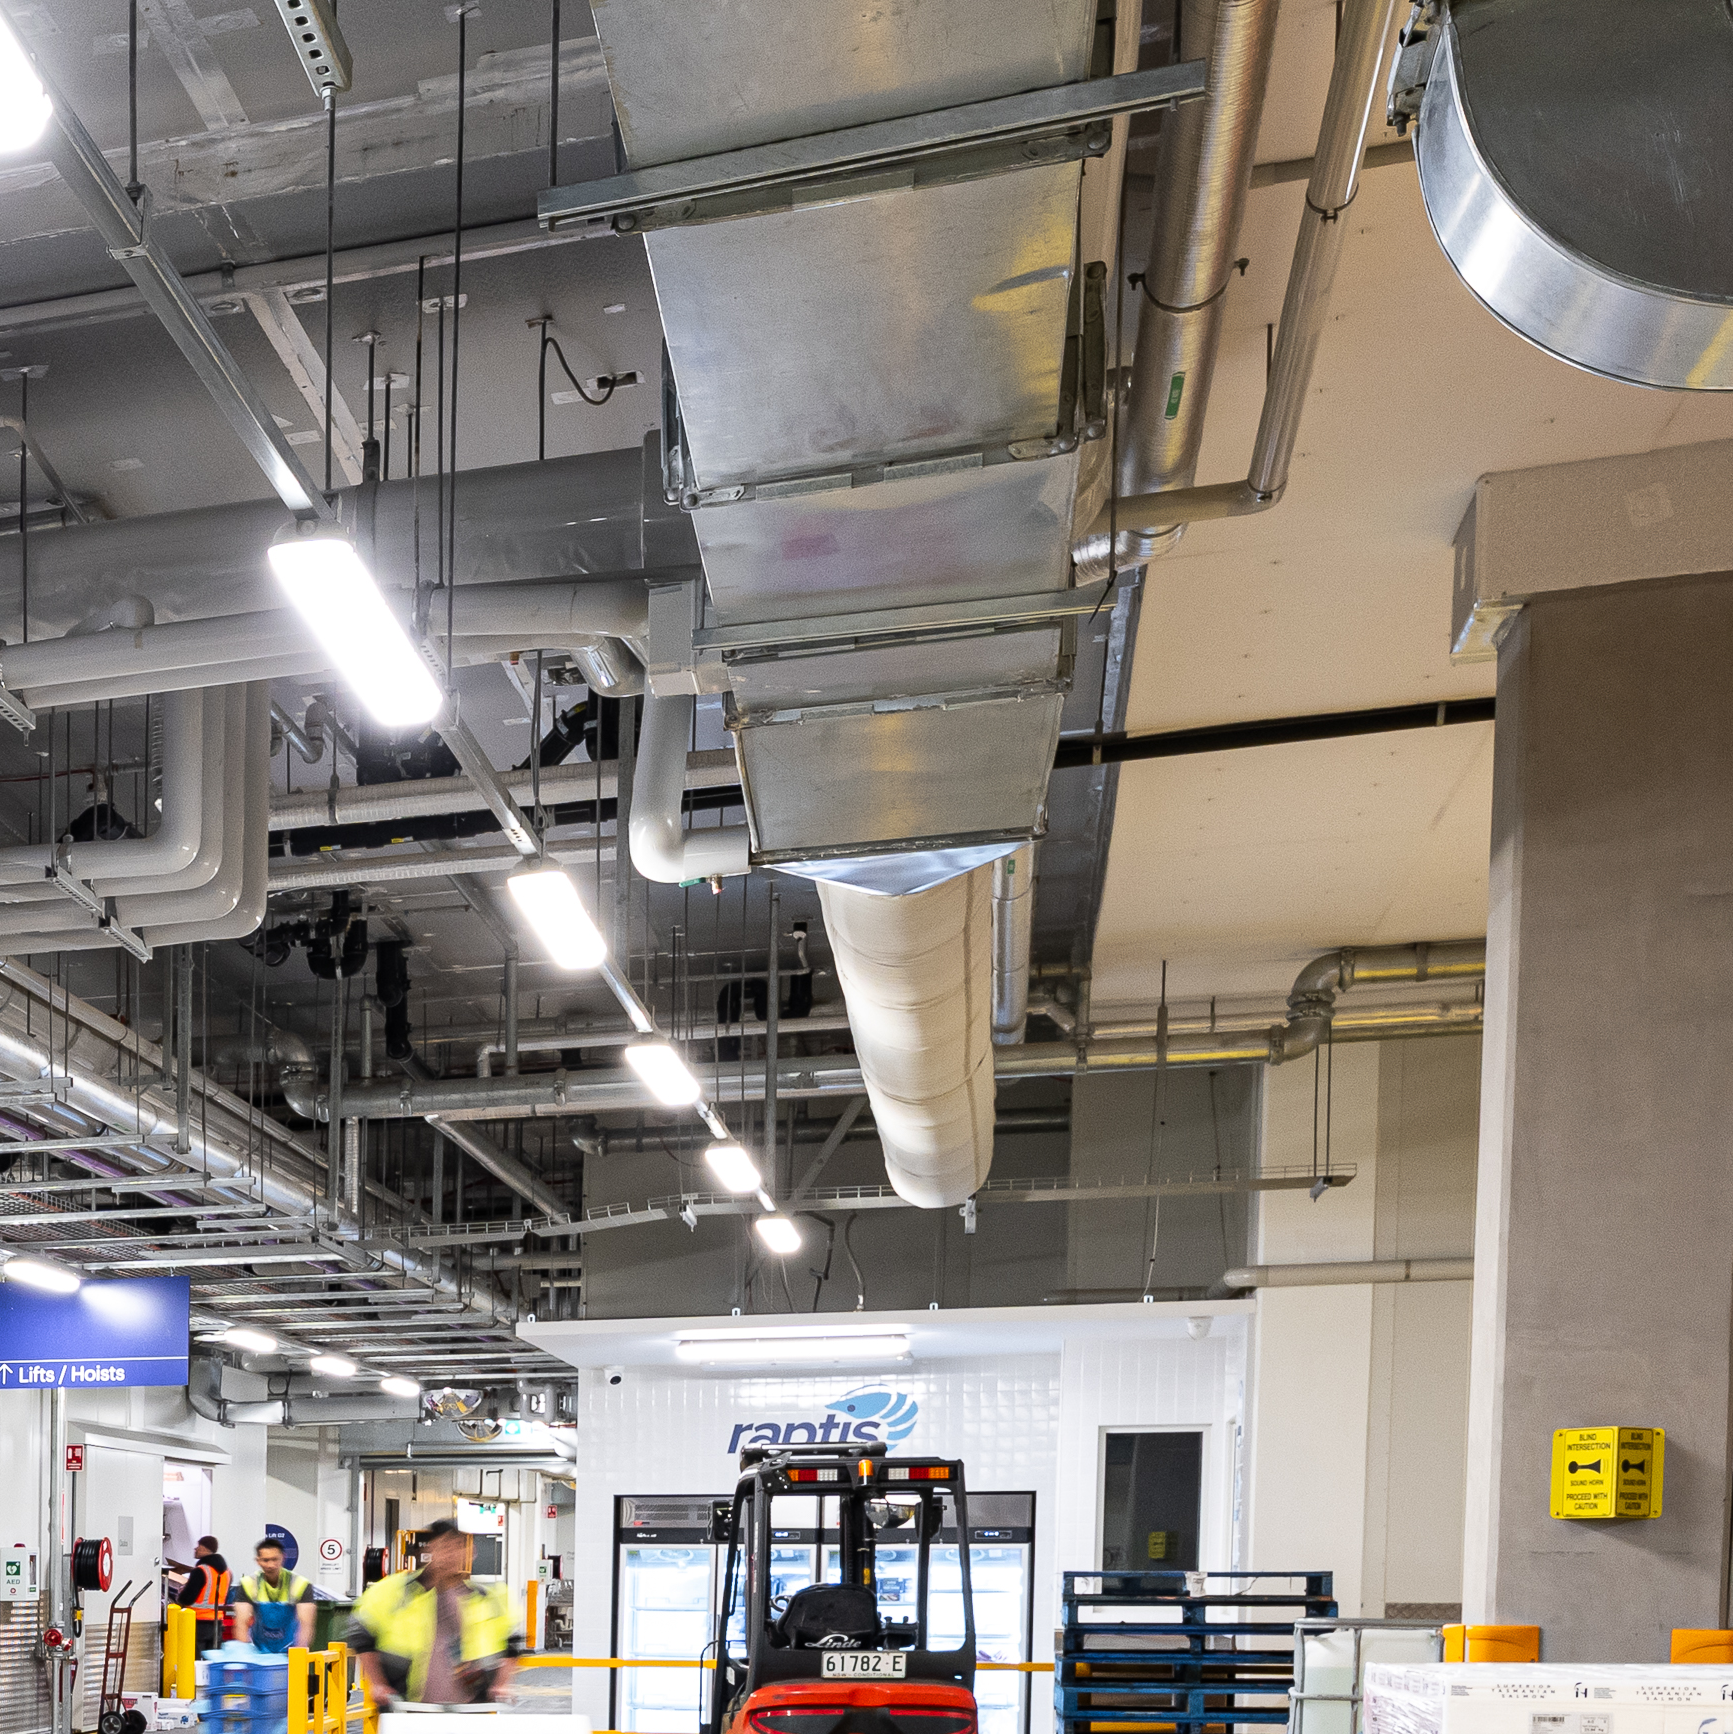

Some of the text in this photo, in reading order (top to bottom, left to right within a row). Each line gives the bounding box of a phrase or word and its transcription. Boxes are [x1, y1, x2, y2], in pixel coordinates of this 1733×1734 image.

[18, 1365, 125, 1385] Lifts / Hoists
[727, 1414, 881, 1454] raptis
[1567, 1443, 1611, 1451] INTERSECTION
[327, 1545, 335, 1554] 5
[805, 1634, 861, 1648] Linde
[827, 1655, 903, 1672] 61782 E
